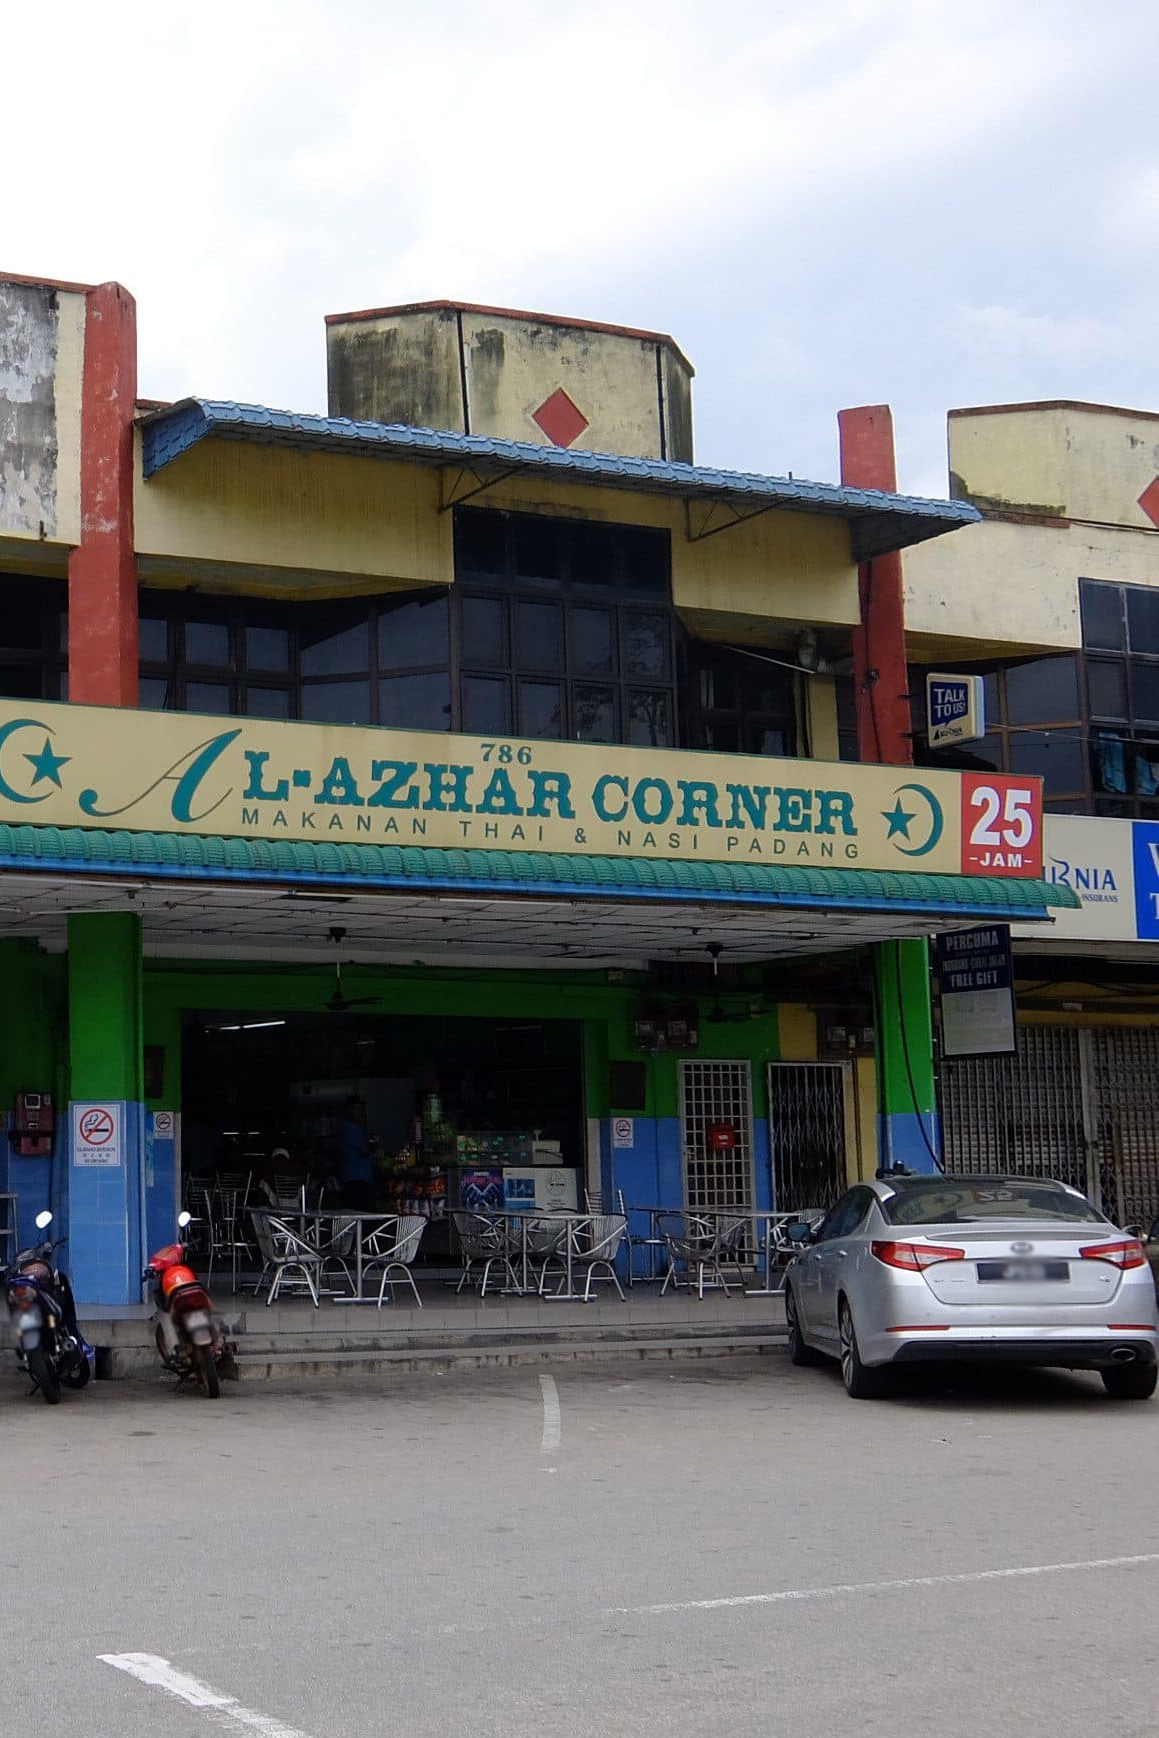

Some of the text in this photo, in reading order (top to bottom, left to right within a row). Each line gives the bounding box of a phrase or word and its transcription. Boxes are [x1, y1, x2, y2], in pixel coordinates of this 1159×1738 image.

[933, 688, 966, 704] TALK
[934, 703, 952, 718] TO
[480, 743, 533, 764] 786
[78, 728, 858, 836] AL-AZHAR CORNER
[969, 786, 1033, 848] 25
[242, 808, 859, 859] MAKANAN THAI & NASI PADANG
[945, 930, 999, 951] PERCUMA
[951, 970, 997, 987] FREE GIFT
